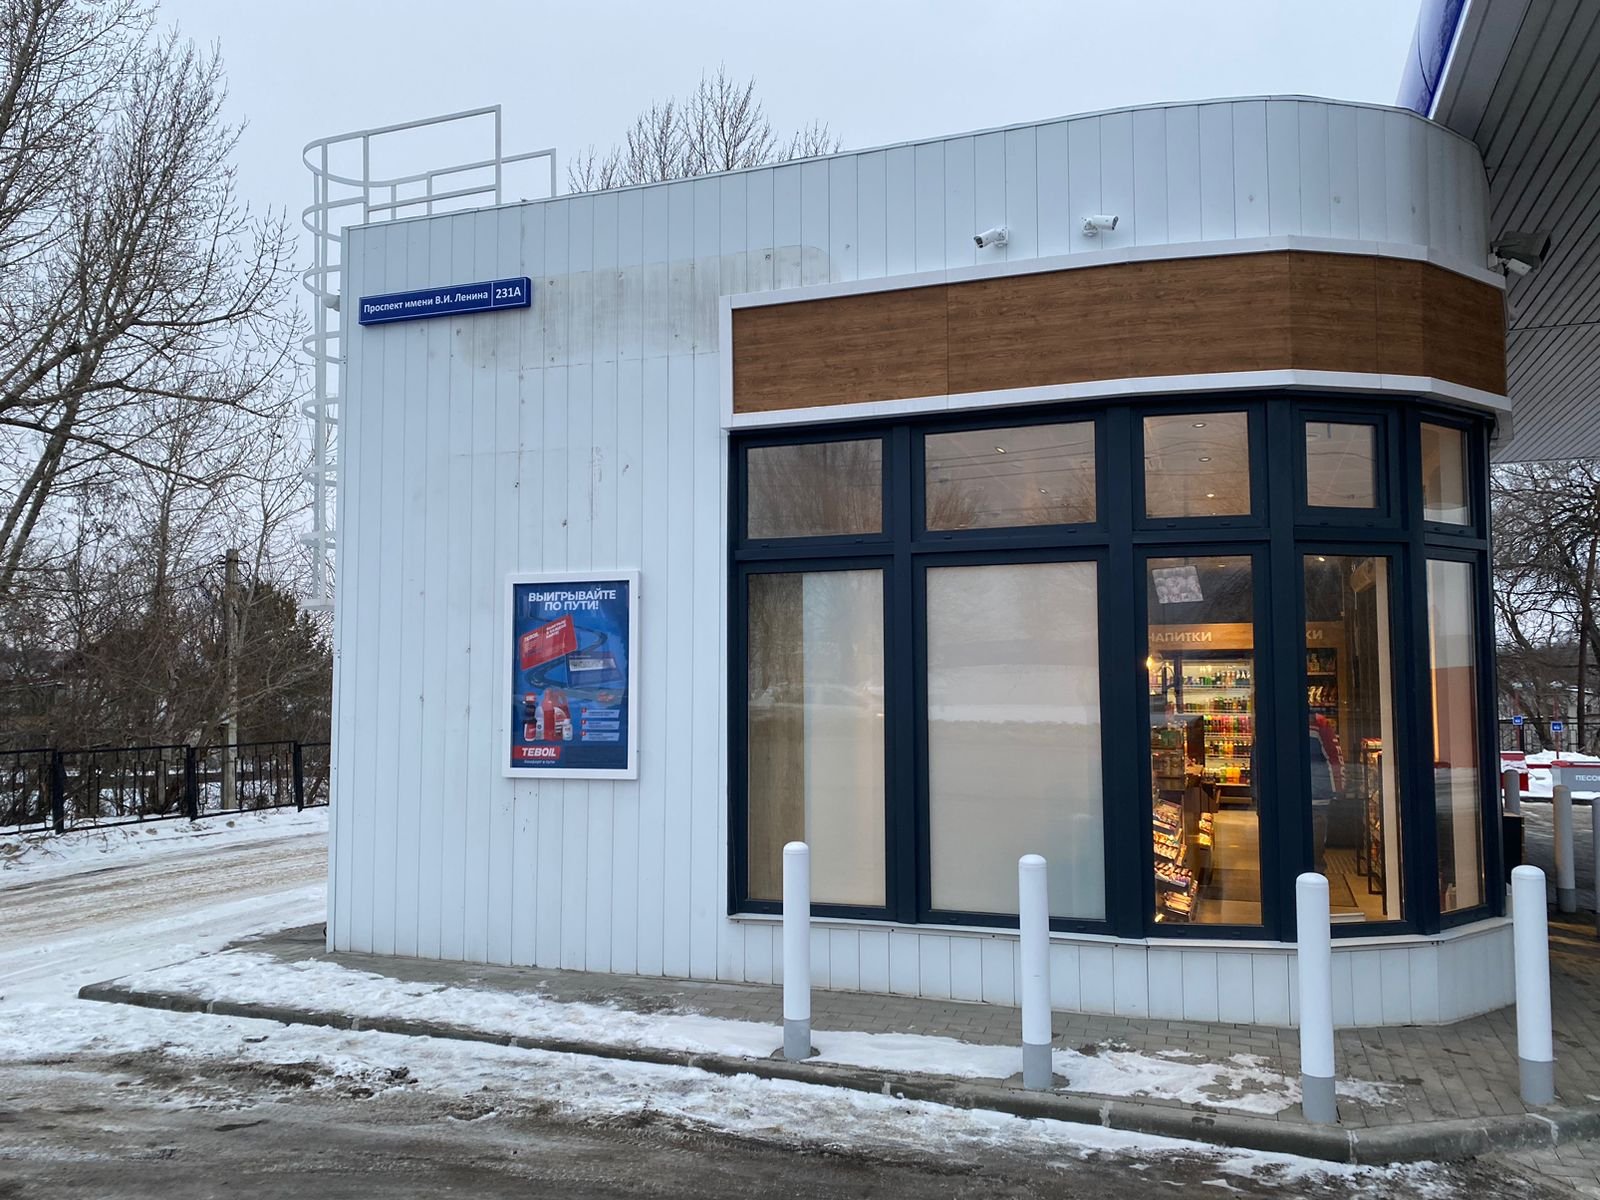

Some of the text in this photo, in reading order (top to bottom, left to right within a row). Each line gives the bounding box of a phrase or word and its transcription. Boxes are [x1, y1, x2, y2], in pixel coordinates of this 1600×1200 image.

[495, 286, 522, 299] 231А
[363, 291, 488, 314] Проспект имени В.И. Ленина
[528, 587, 617, 602] ВЫИГРЫВАЙТЕ
[544, 600, 599, 611] ПО ПУТИ!
[521, 747, 557, 757] TEBOIL
